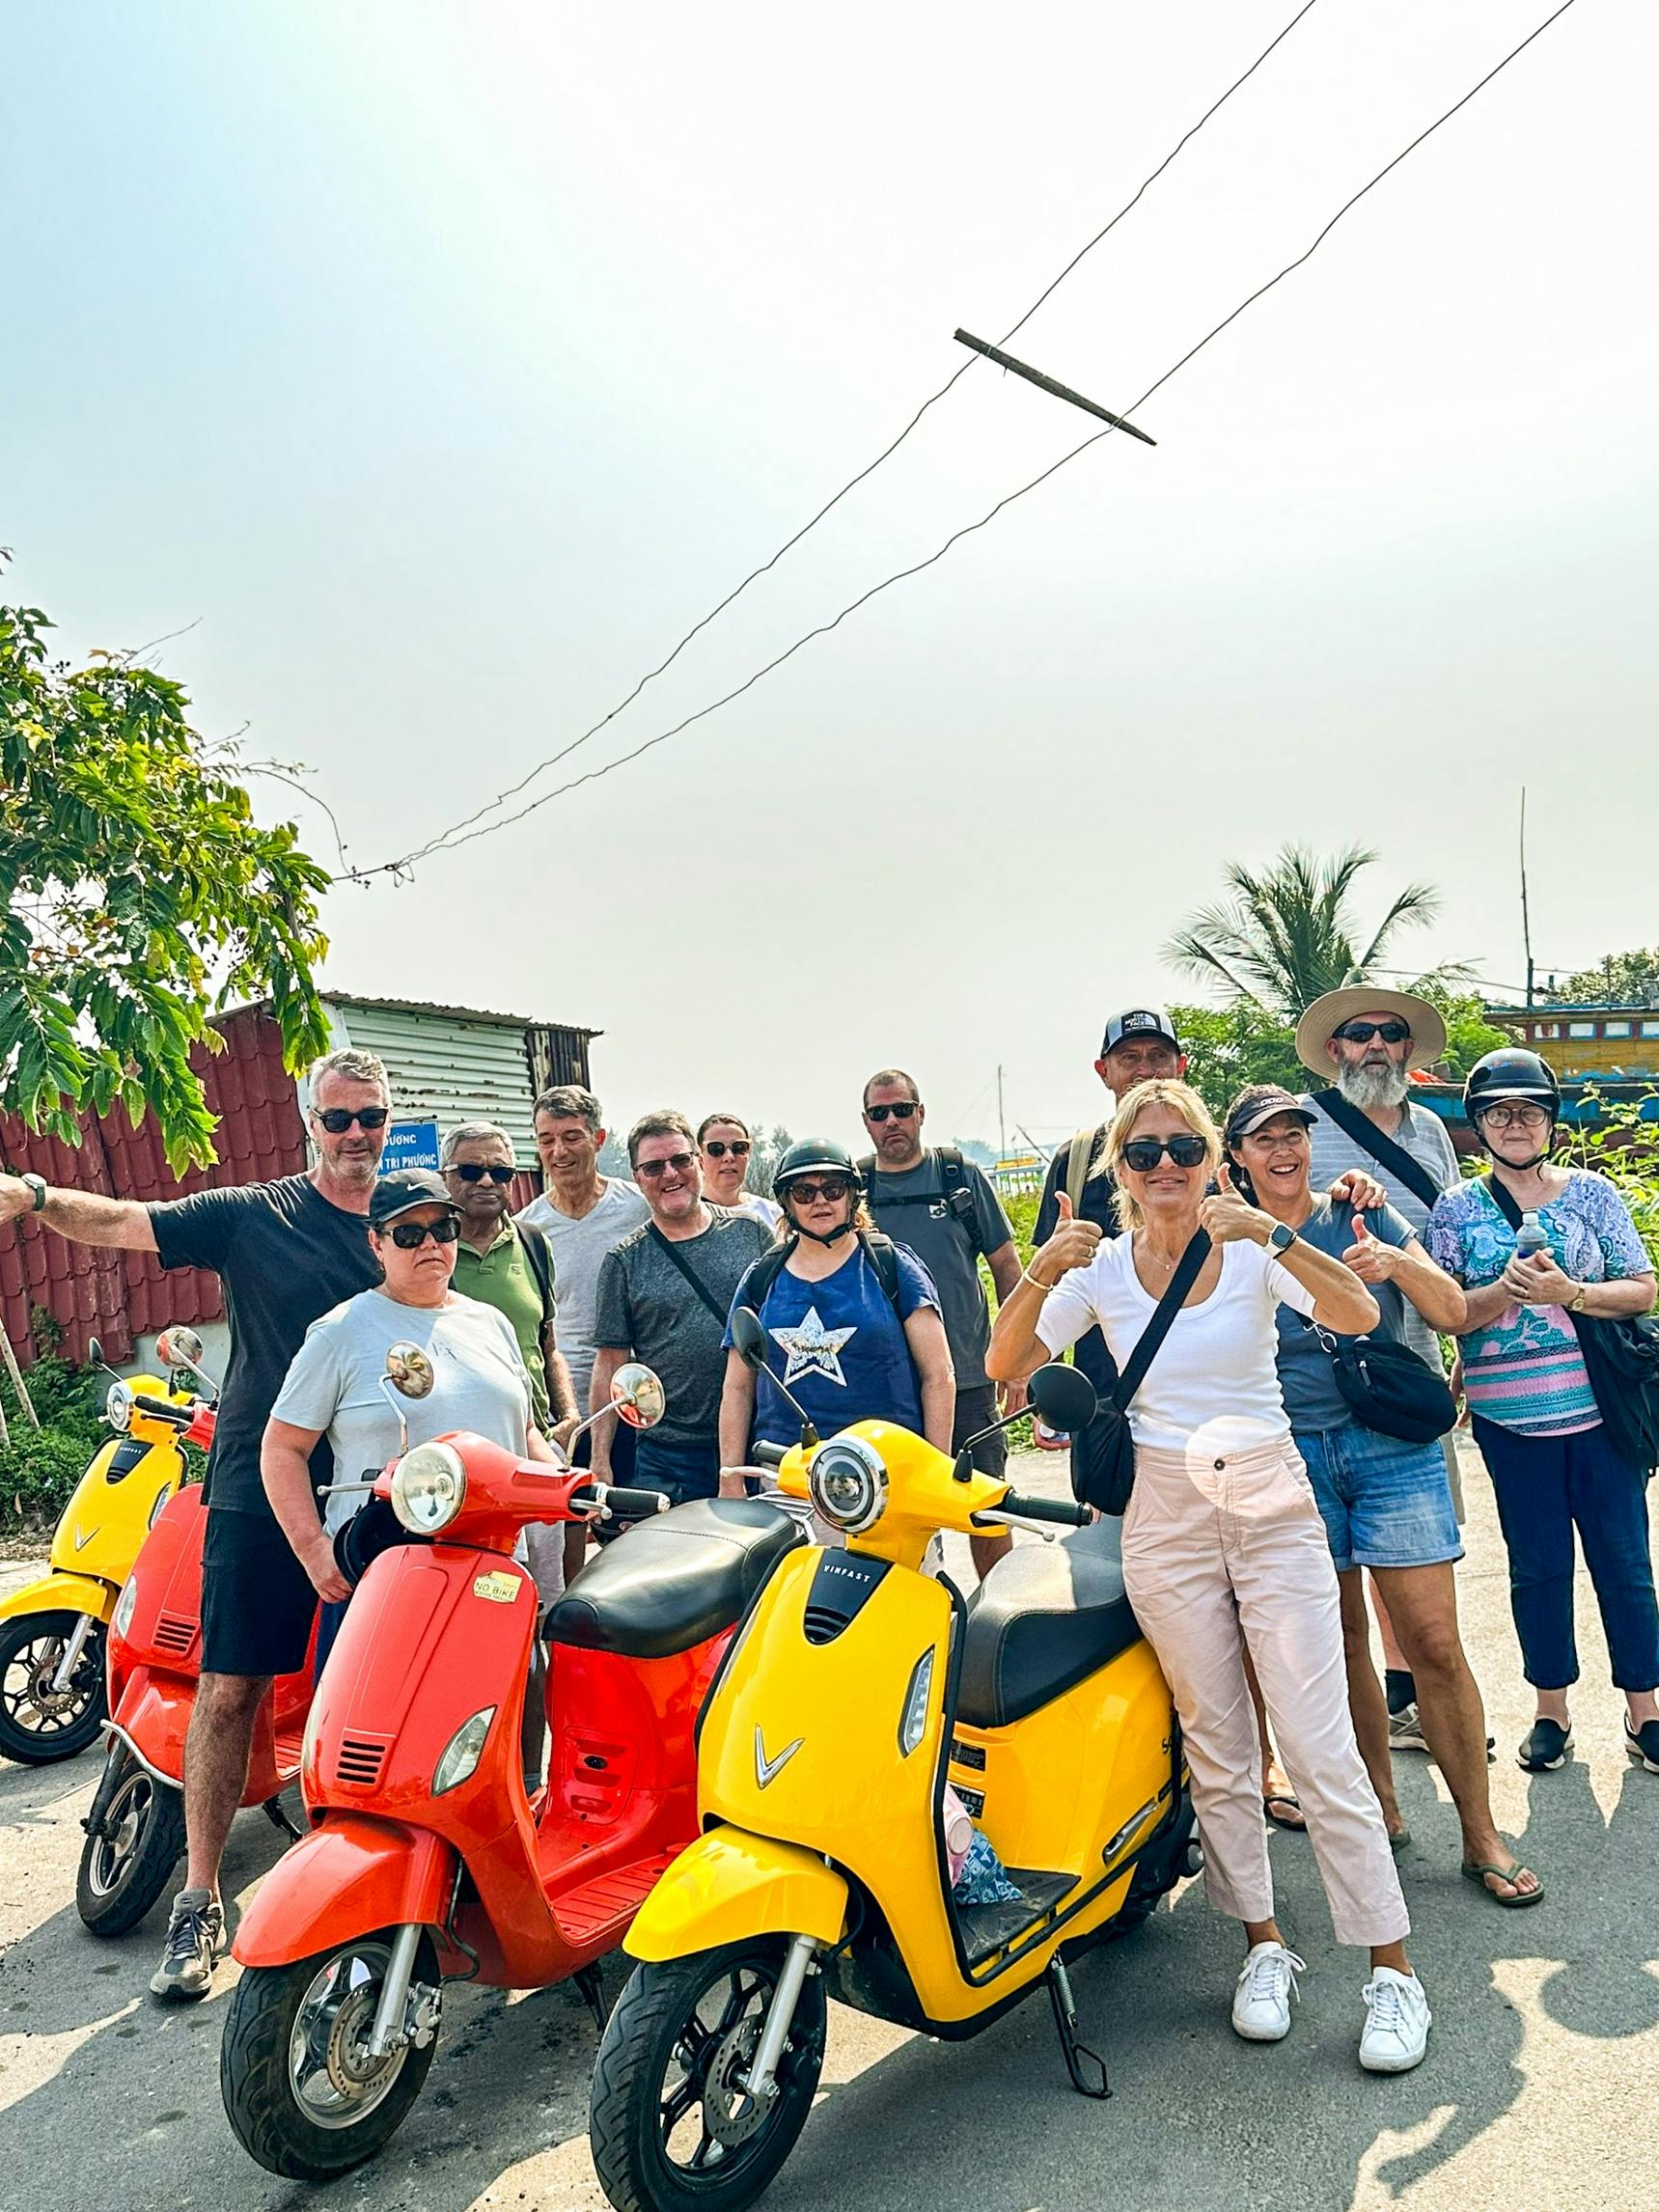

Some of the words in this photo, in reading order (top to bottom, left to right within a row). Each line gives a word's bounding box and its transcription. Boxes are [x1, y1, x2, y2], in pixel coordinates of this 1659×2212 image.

[385, 1157, 401, 1170] TRI
[823, 1564, 871, 1583] VINFAST
[475, 1582, 490, 1591] NO
[492, 1586, 515, 1600] BIKE
